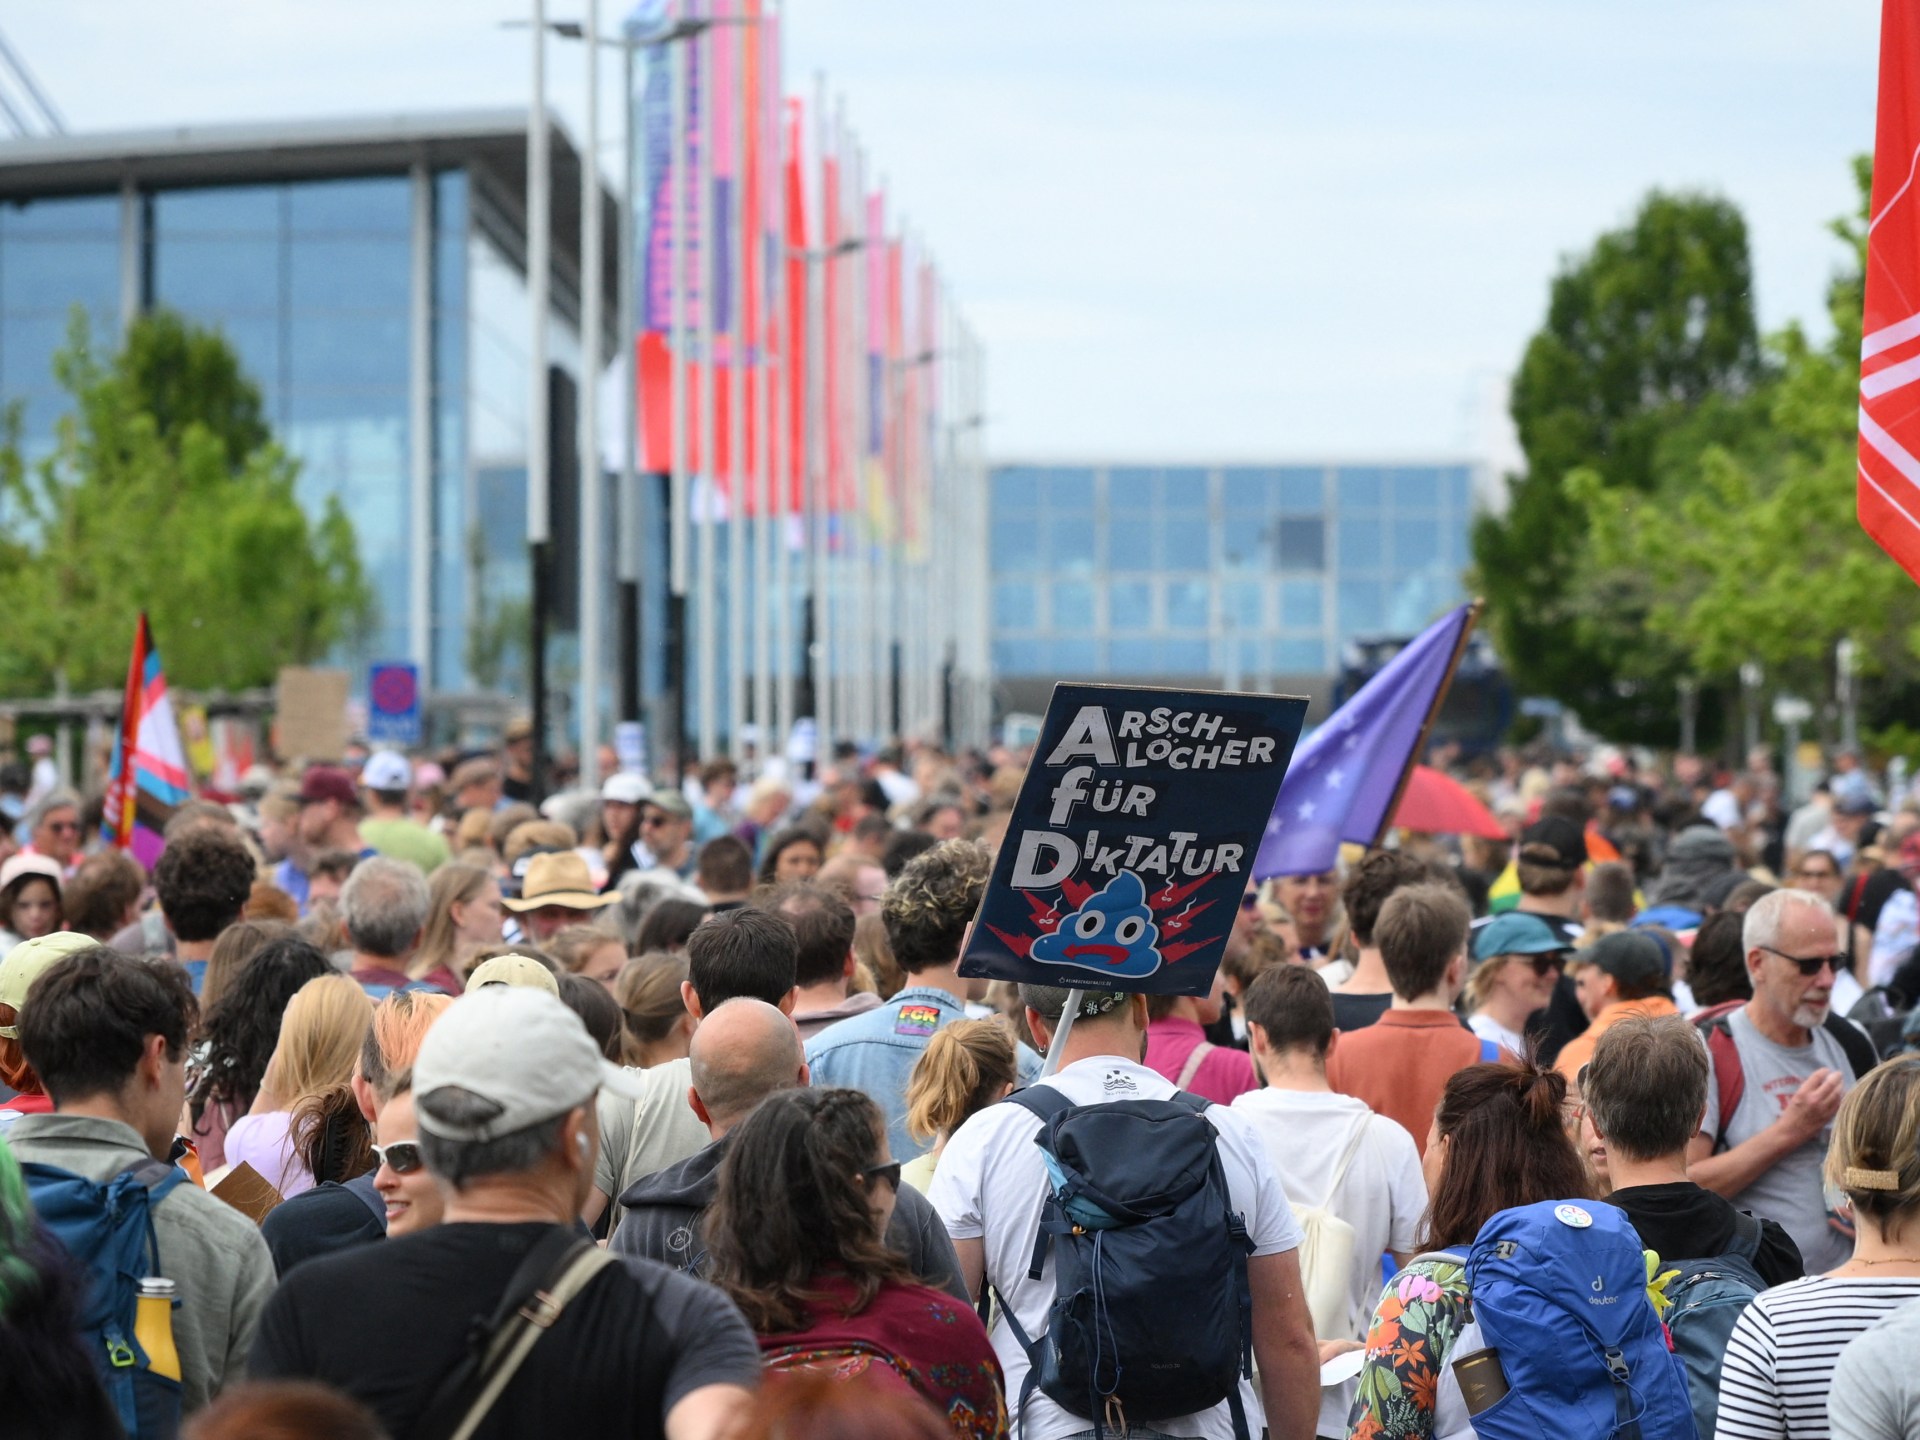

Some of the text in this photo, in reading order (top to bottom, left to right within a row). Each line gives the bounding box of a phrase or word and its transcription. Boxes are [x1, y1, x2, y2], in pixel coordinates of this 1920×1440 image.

[1126, 734, 1276, 770] LÖCHER
[1010, 830, 1244, 890] DIKTATUR
[899, 1006, 938, 1022] FCK
[1588, 1296, 1618, 1305] deuter
